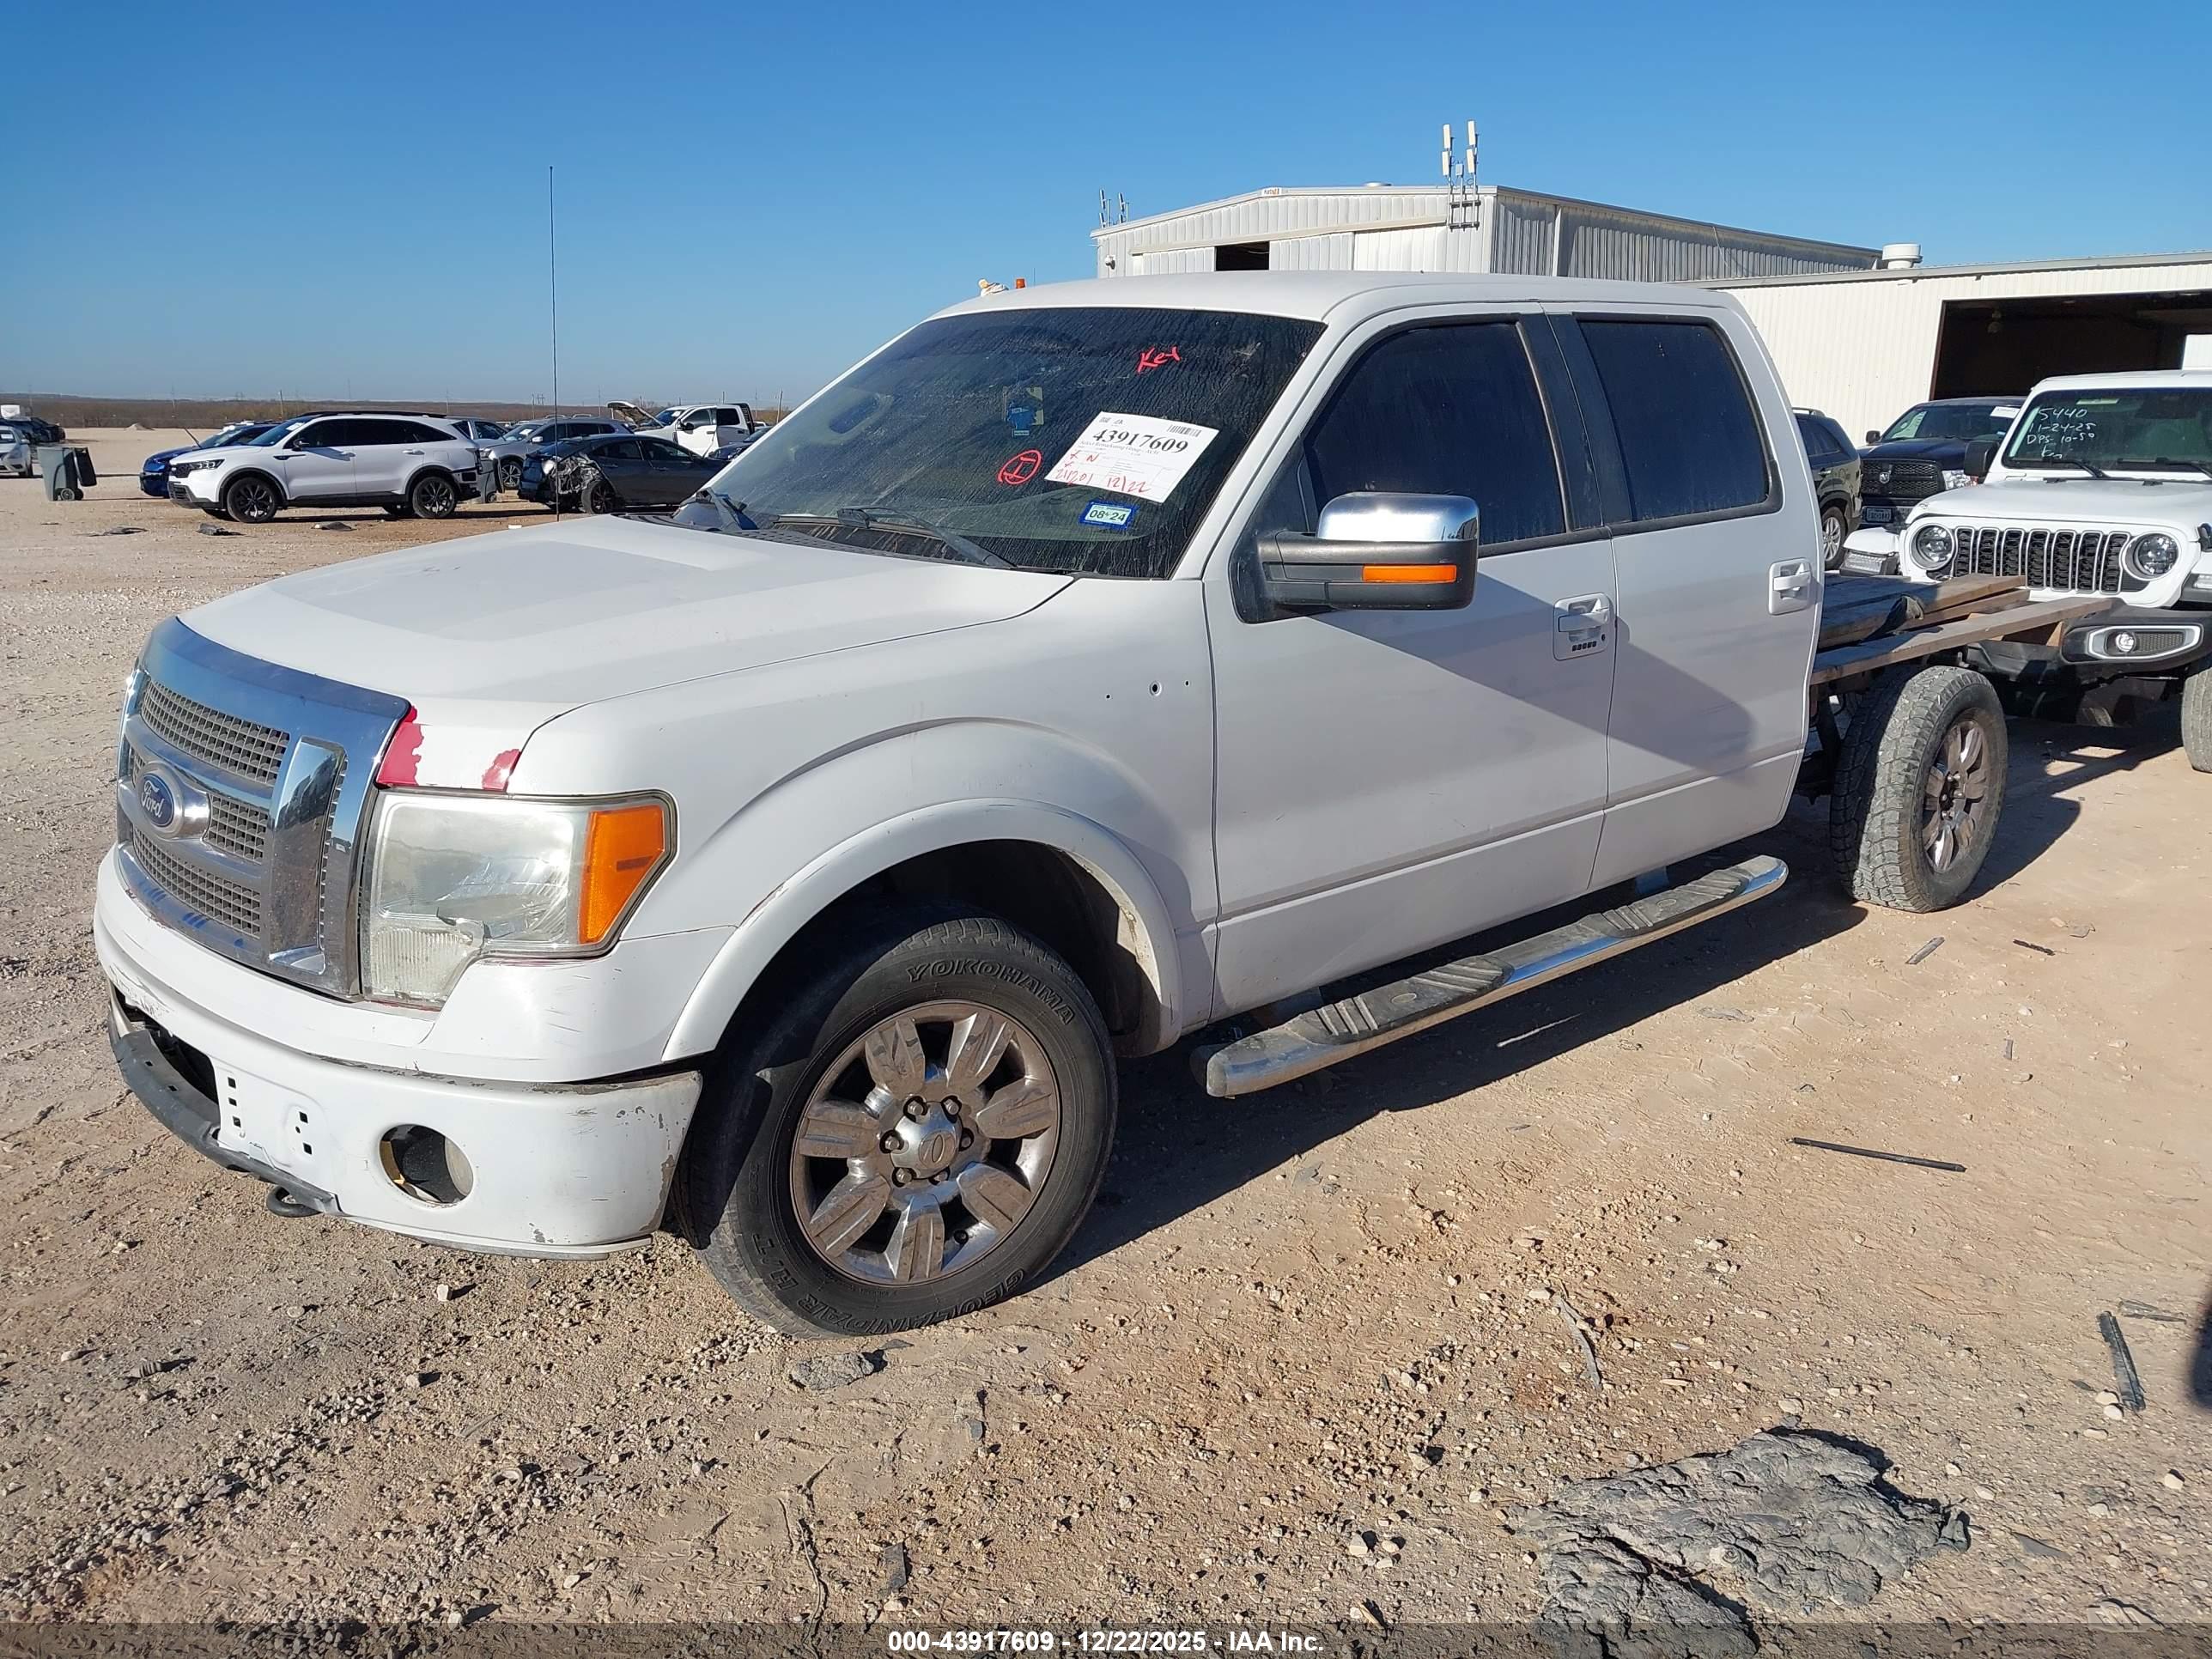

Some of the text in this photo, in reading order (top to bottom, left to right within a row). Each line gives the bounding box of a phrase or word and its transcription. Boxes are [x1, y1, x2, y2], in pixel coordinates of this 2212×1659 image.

[2038, 407, 2087, 421] 5440
[1092, 428, 1189, 453] 43917609
[1106, 475, 1152, 494] 12/22
[140, 779, 166, 818] Ford
[905, 958, 1077, 1025] YOKOHAMA
